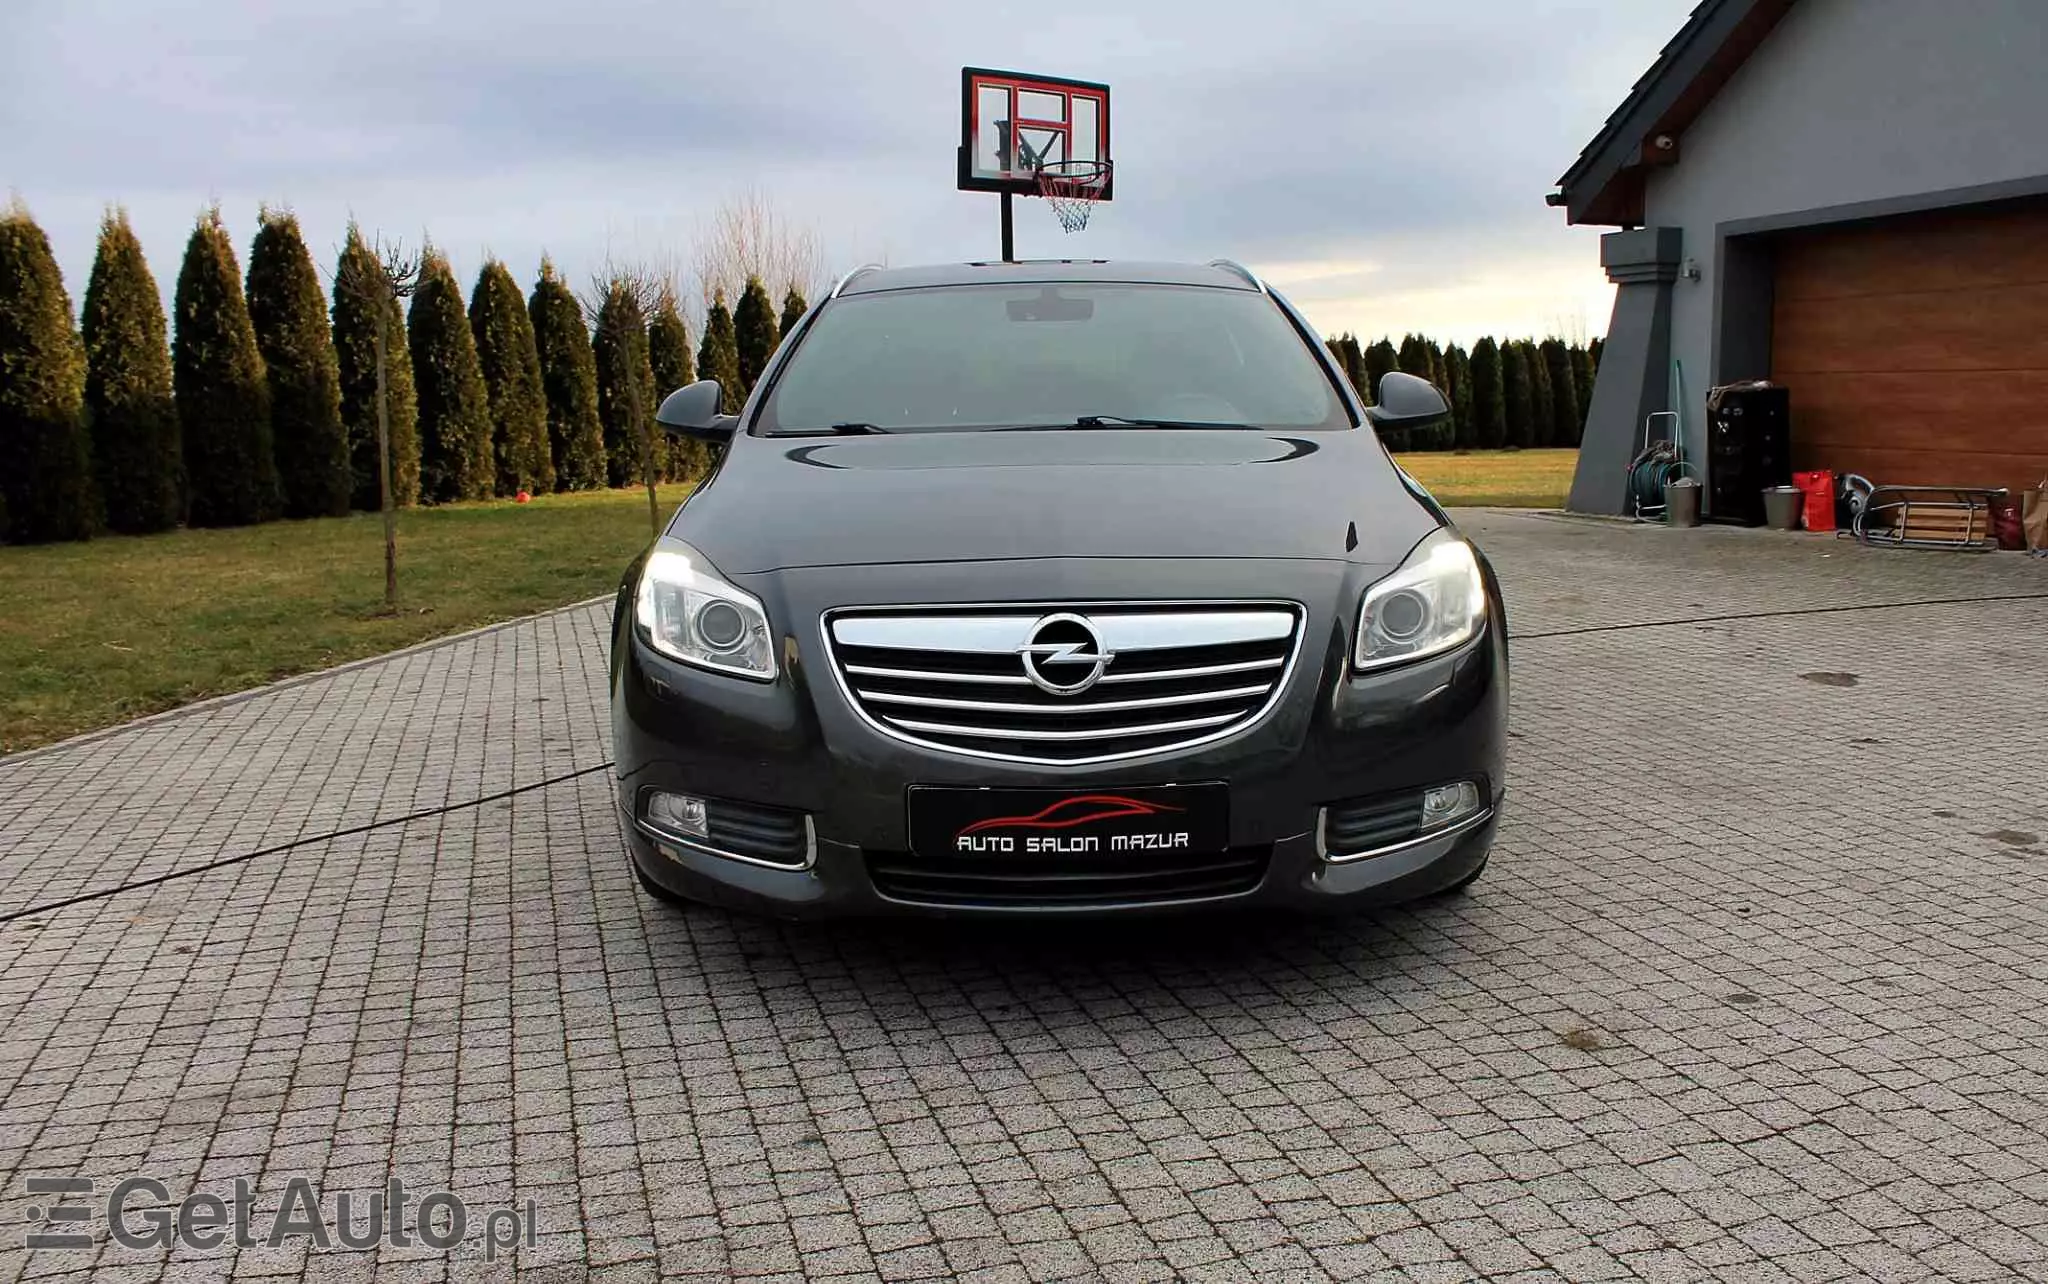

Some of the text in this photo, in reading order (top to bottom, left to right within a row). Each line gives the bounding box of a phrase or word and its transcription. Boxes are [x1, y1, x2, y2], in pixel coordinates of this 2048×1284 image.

[957, 832, 1188, 852] AUTO SALON MAZUR
